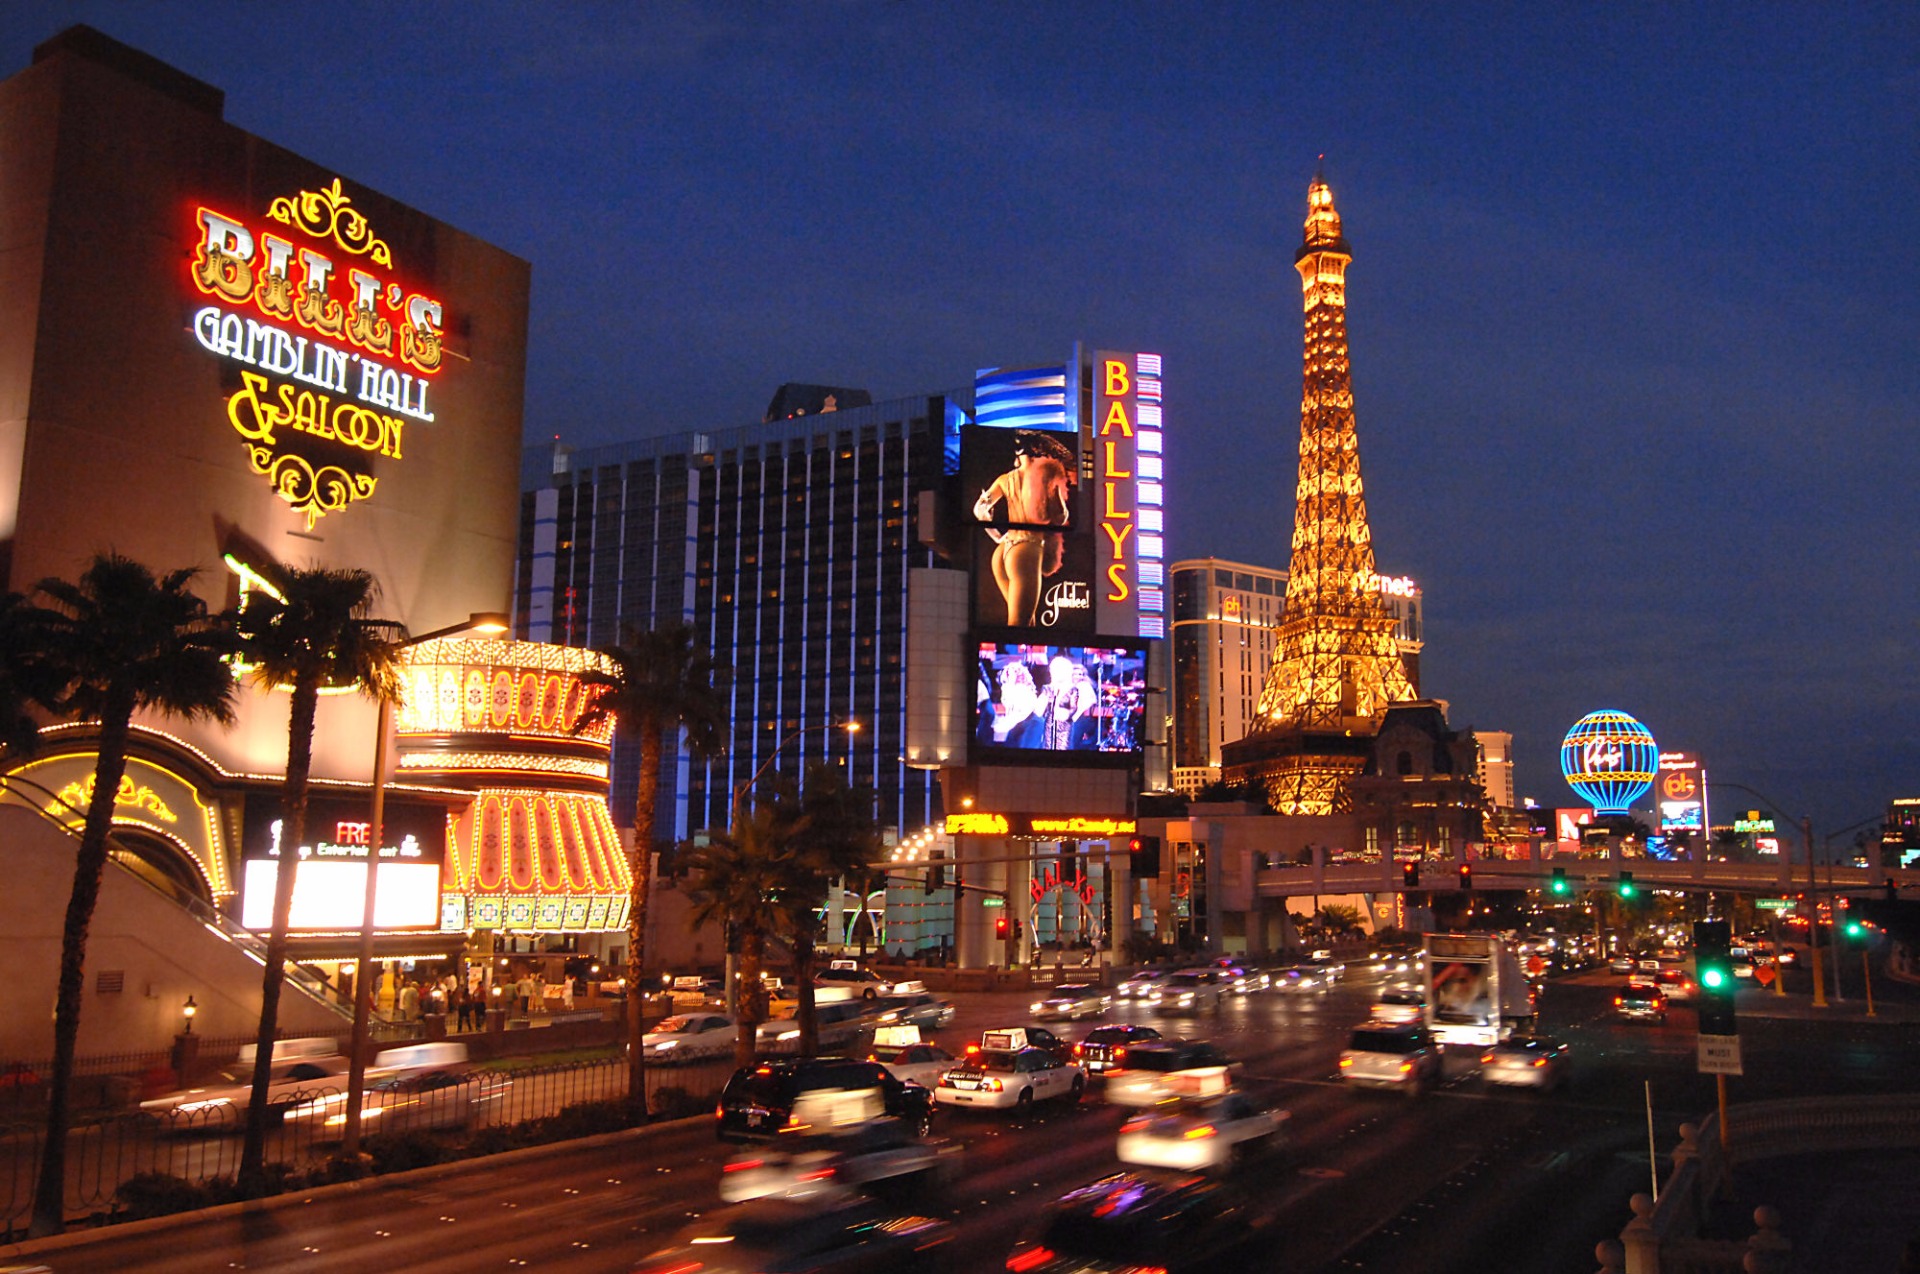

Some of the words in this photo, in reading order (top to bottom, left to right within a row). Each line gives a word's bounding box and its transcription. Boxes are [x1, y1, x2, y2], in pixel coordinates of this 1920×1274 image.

[191, 207, 444, 374] BILL'S
[194, 306, 361, 395] GAMBLIN'
[357, 356, 434, 422] HALL
[227, 370, 280, 445] &
[276, 384, 404, 460] SALOON
[1100, 359, 1134, 602] BALLYS
[1583, 735, 1622, 778] Paris
[336, 821, 384, 844] FRE
[1734, 819, 1775, 832] MGM
[1707, 1048, 1731, 1057] MUST
